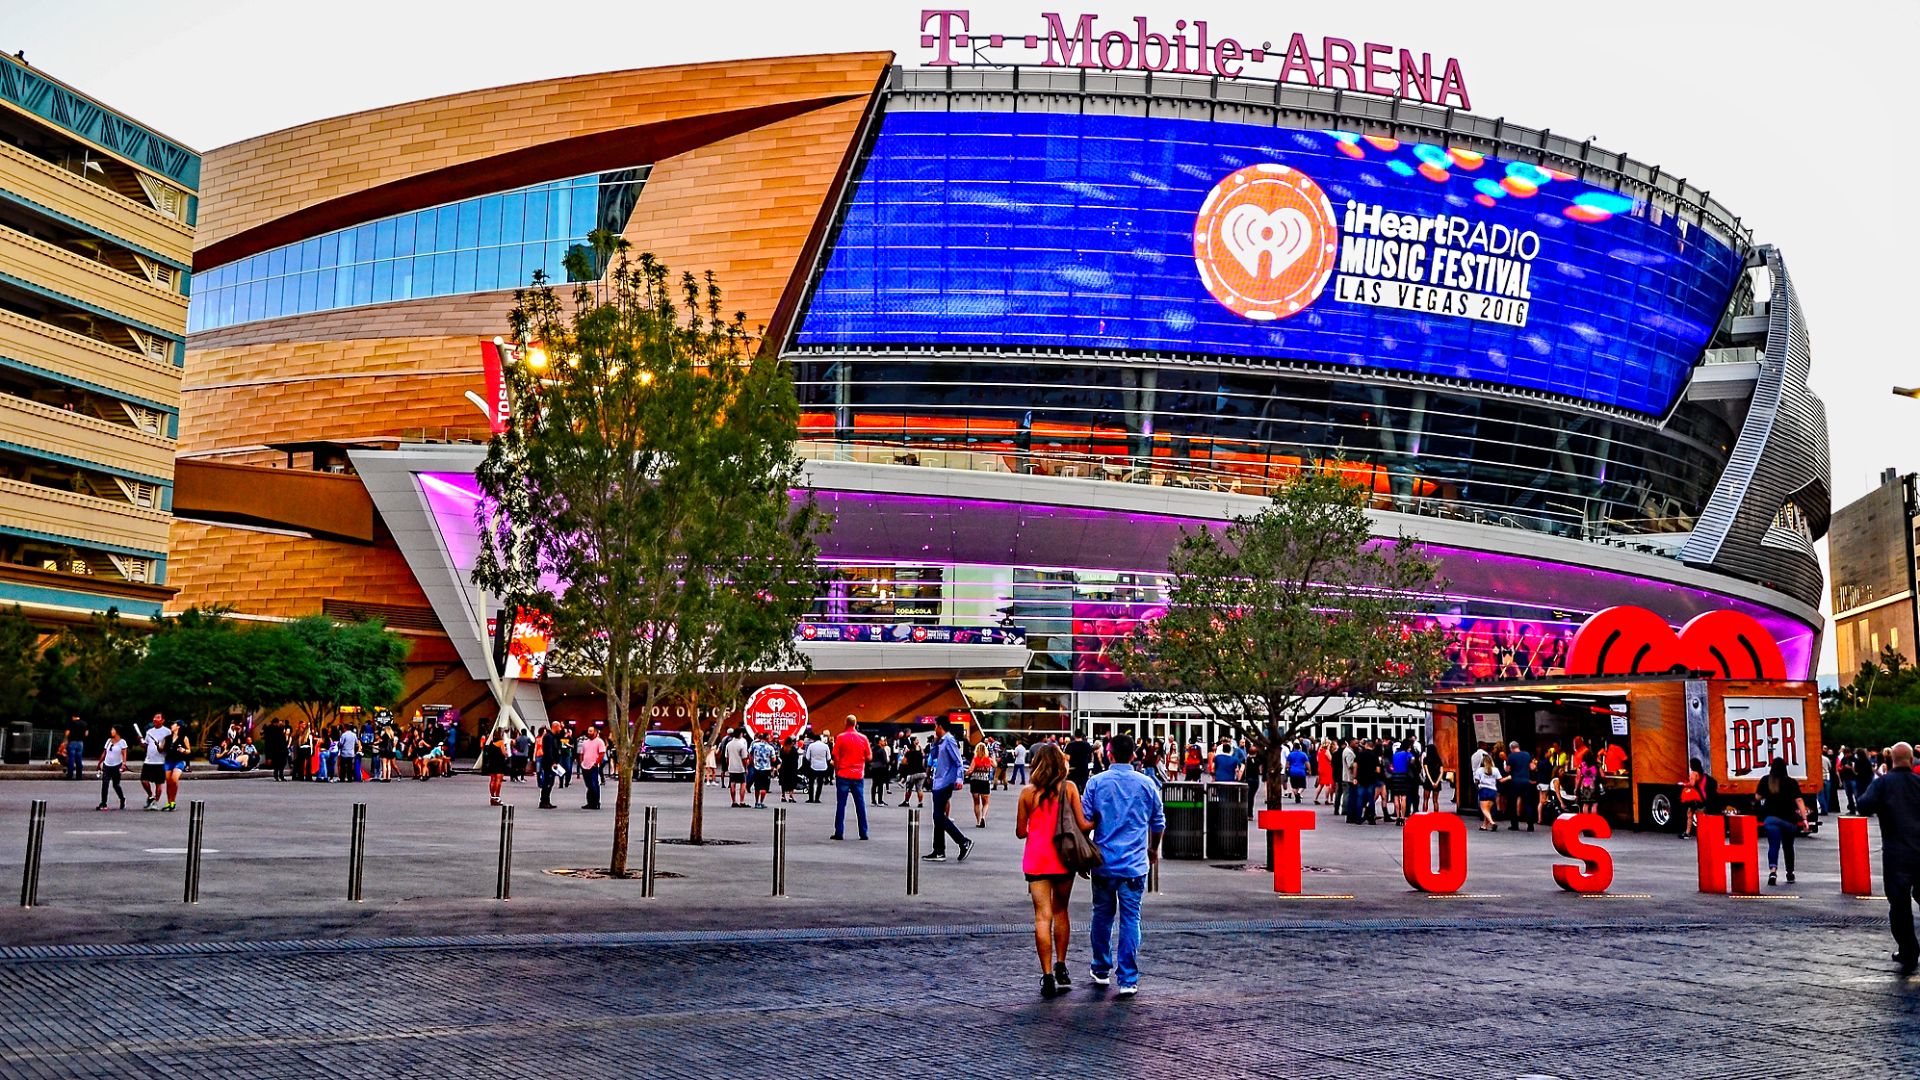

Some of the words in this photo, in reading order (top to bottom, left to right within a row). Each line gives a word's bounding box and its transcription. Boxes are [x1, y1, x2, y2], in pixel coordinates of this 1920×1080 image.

[1279, 33, 1472, 111] ARENA
[1340, 236, 1427, 283] MUSIC
[1429, 246, 1532, 300] FESTIVAL
[1339, 283, 1383, 304] LAS
[1398, 287, 1469, 317] VEGAS
[1481, 299, 1526, 324] 2016
[641, 706, 670, 718] OX
[1730, 717, 1799, 776] BEER
